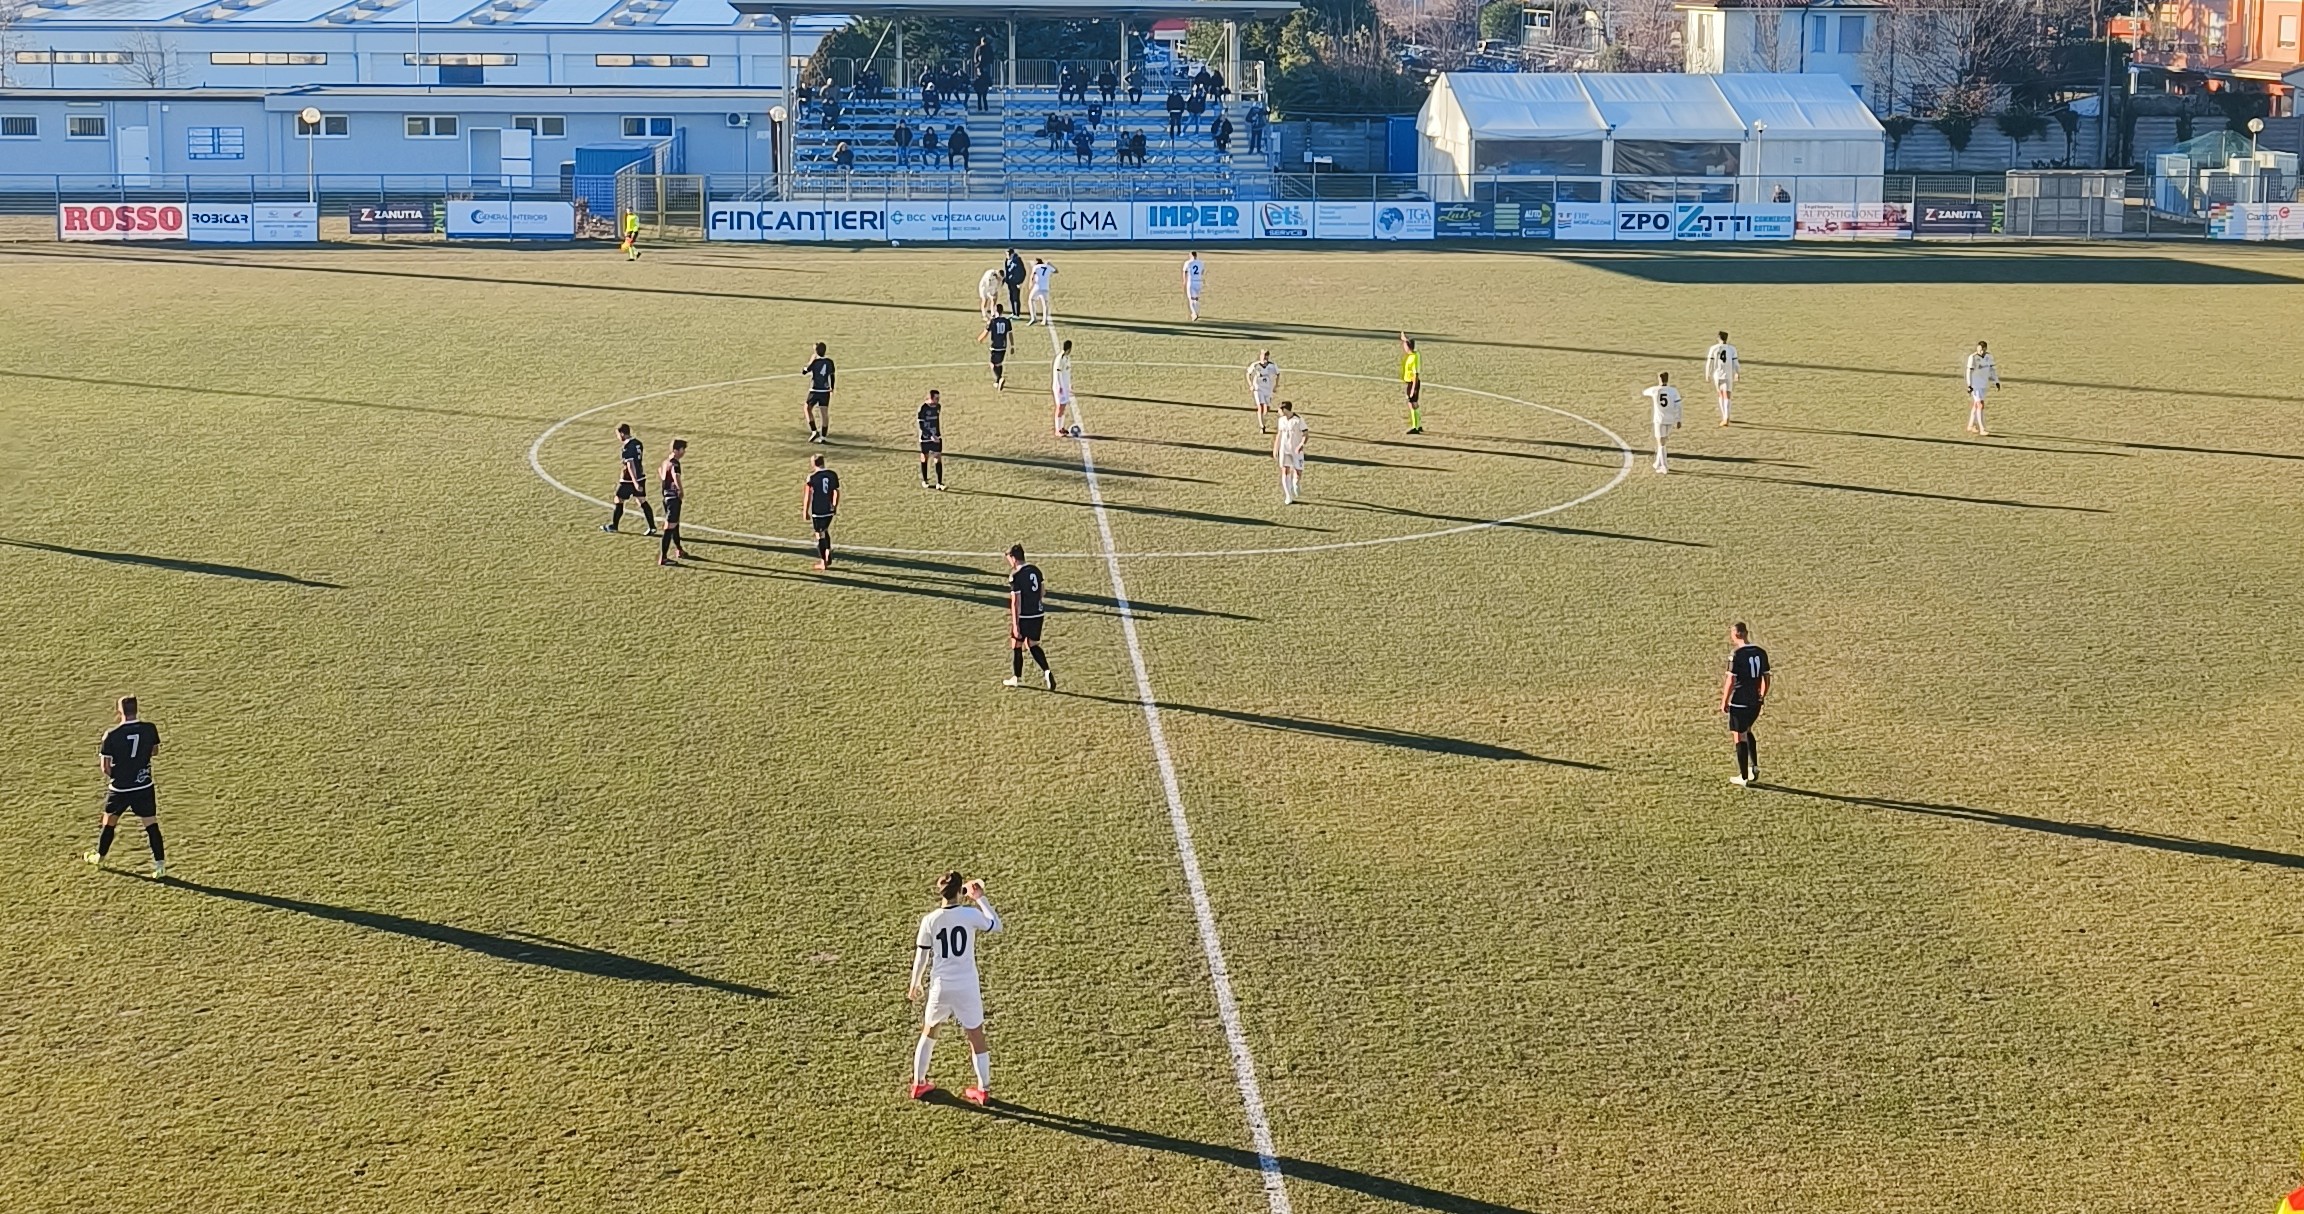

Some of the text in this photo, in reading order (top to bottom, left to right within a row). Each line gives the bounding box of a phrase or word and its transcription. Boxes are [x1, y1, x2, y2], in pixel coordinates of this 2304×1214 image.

[64, 206, 183, 231] ROSSO
[374, 210, 423, 219] ZANUTTA
[478, 213, 548, 221] GENERAL INTERIORS
[712, 210, 885, 230] FINCANTIERI
[906, 214, 1006, 222] BCC VENEZIA GIULIA
[1060, 211, 1118, 230] GMA
[1150, 206, 1240, 227] IMPER
[1406, 208, 1432, 220] TGA
[1938, 210, 1983, 219] ZANUTTA
[1620, 214, 1670, 230] ZPO
[1040, 266, 1048, 277] 7
[1192, 265, 1199, 275] 2
[996, 321, 1006, 334] 10
[1719, 350, 1727, 363] 4
[820, 363, 827, 376] 4
[1659, 393, 1668, 407] 5
[822, 477, 829, 494] 6
[1029, 573, 1039, 592] 3
[1749, 655, 1761, 678] 11
[127, 733, 140, 758] 7
[936, 925, 968, 959] 10
